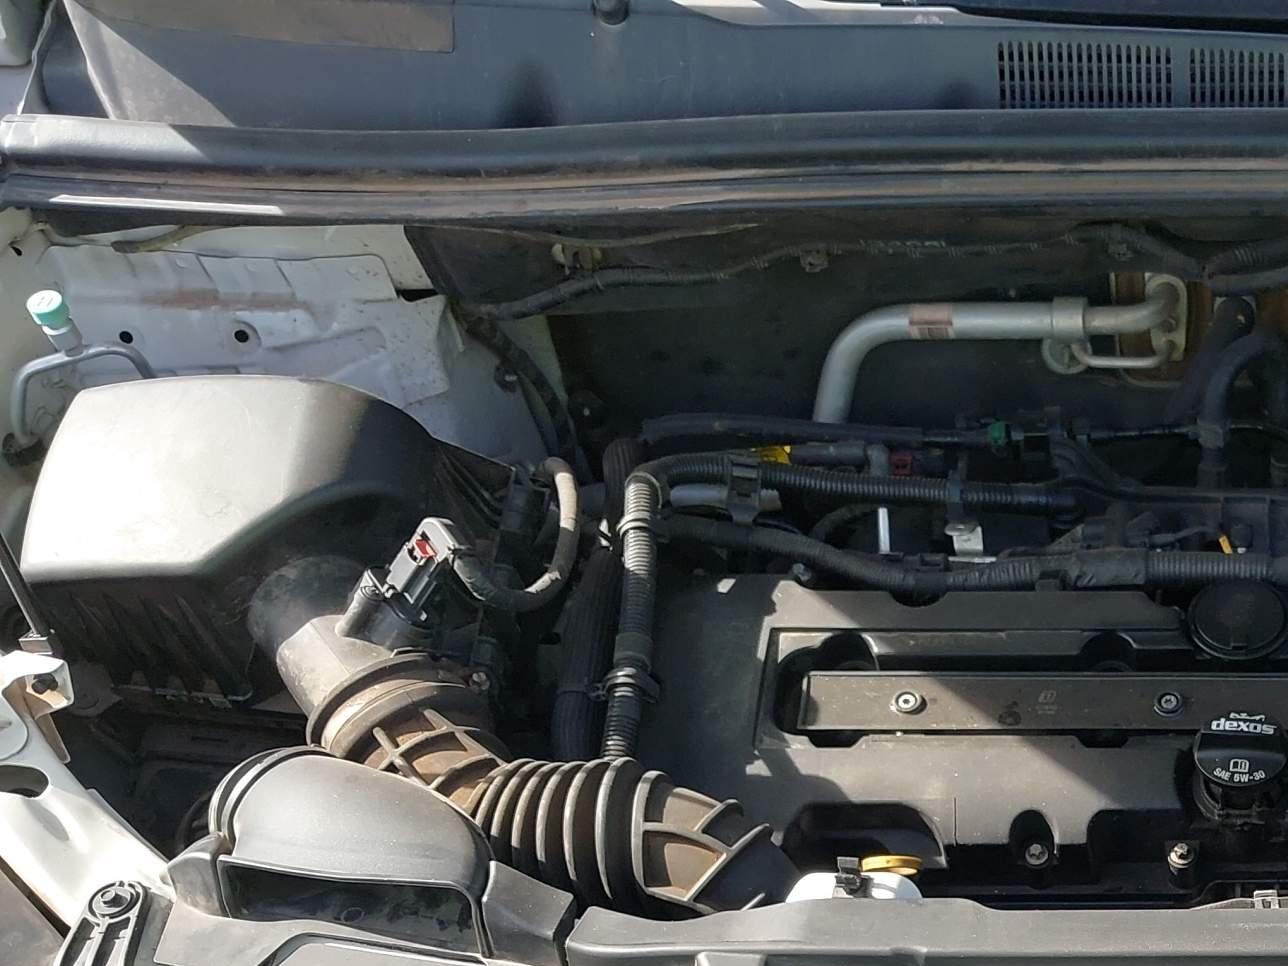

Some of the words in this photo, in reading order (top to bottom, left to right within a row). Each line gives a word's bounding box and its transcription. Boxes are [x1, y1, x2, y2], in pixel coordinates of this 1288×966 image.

[1211, 717, 1277, 735] dexos
[1213, 767, 1231, 781] SAE
[1233, 770, 1266, 783] 5W-30
